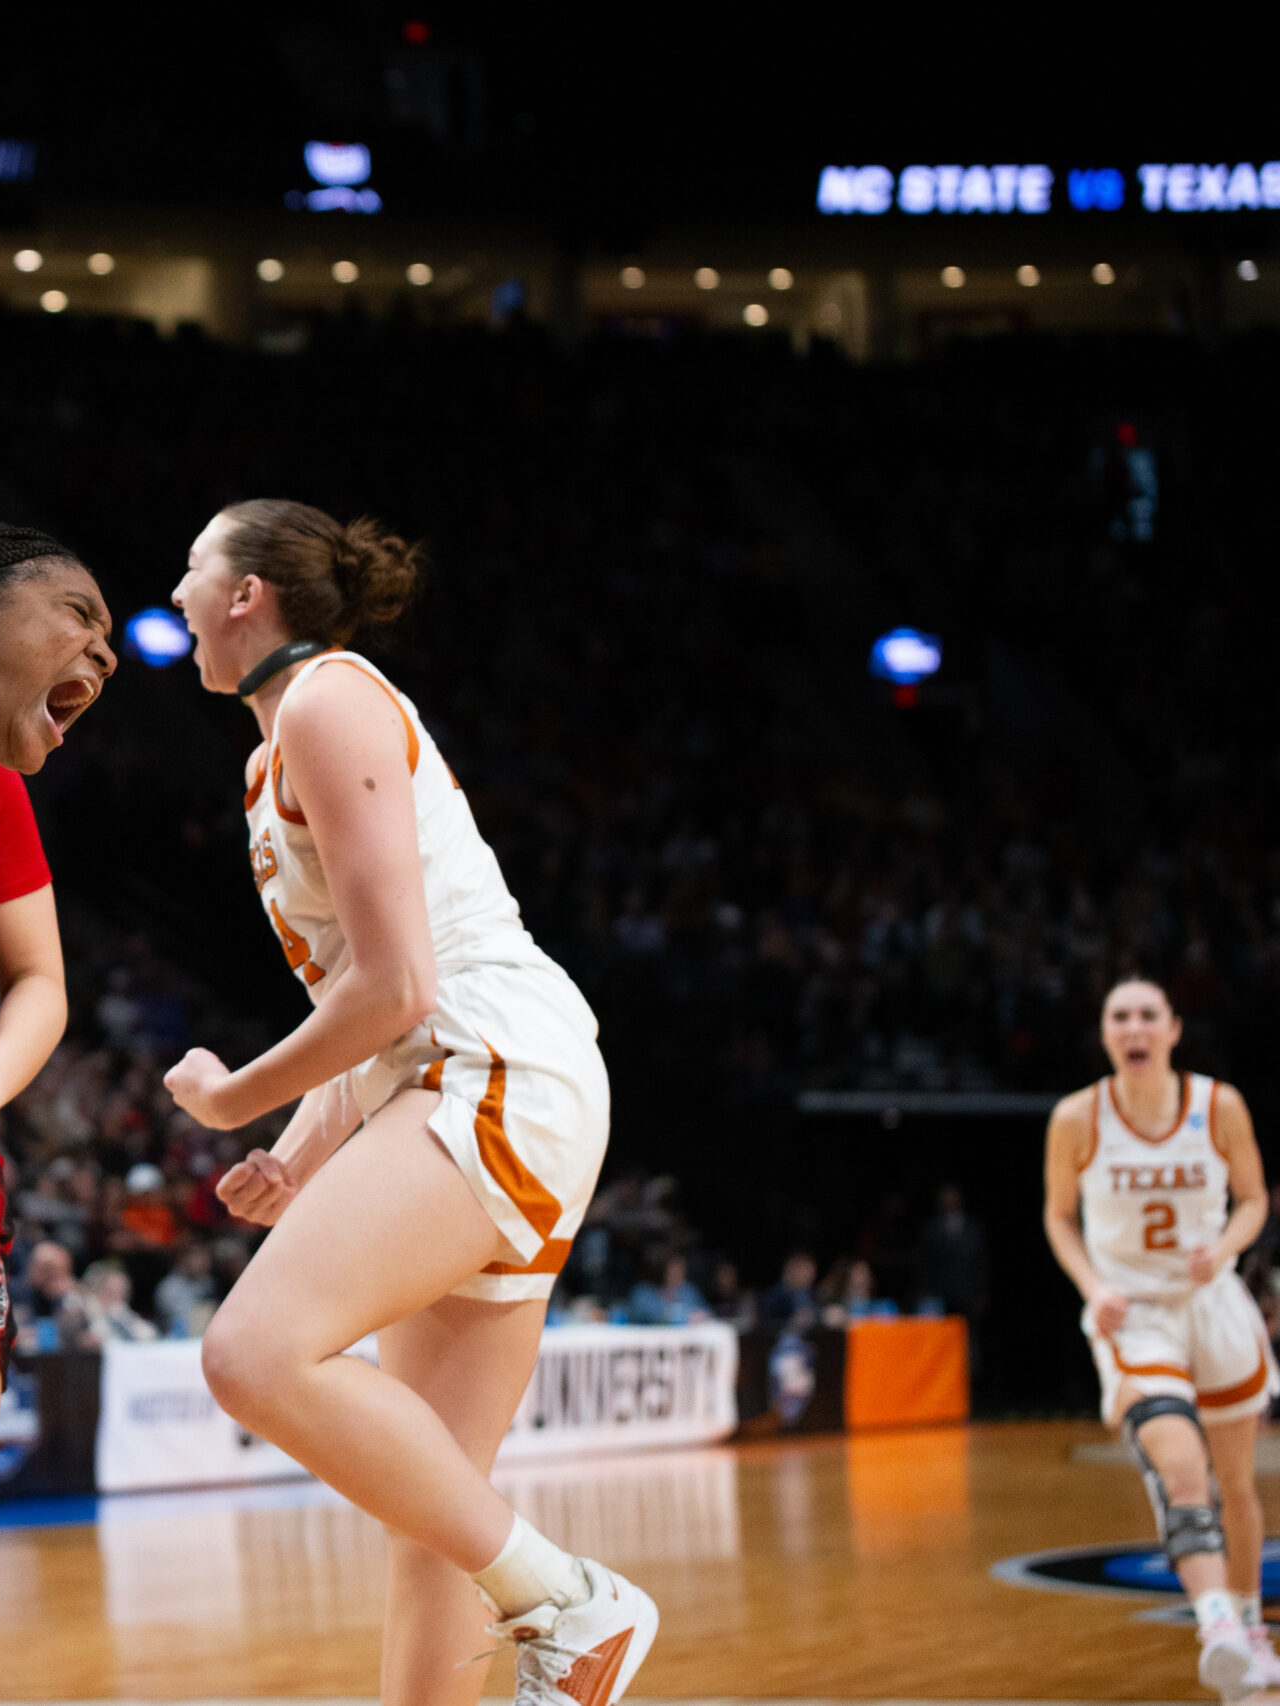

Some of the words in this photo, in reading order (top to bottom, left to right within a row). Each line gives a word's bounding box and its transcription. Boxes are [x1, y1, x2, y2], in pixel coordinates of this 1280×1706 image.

[818, 165, 893, 214] NC
[898, 164, 1053, 214] STATE
[1109, 1163, 1207, 1191] TEXAS
[1142, 1200, 1179, 1251] 2
[529, 1343, 719, 1429] UNIVERSITY
